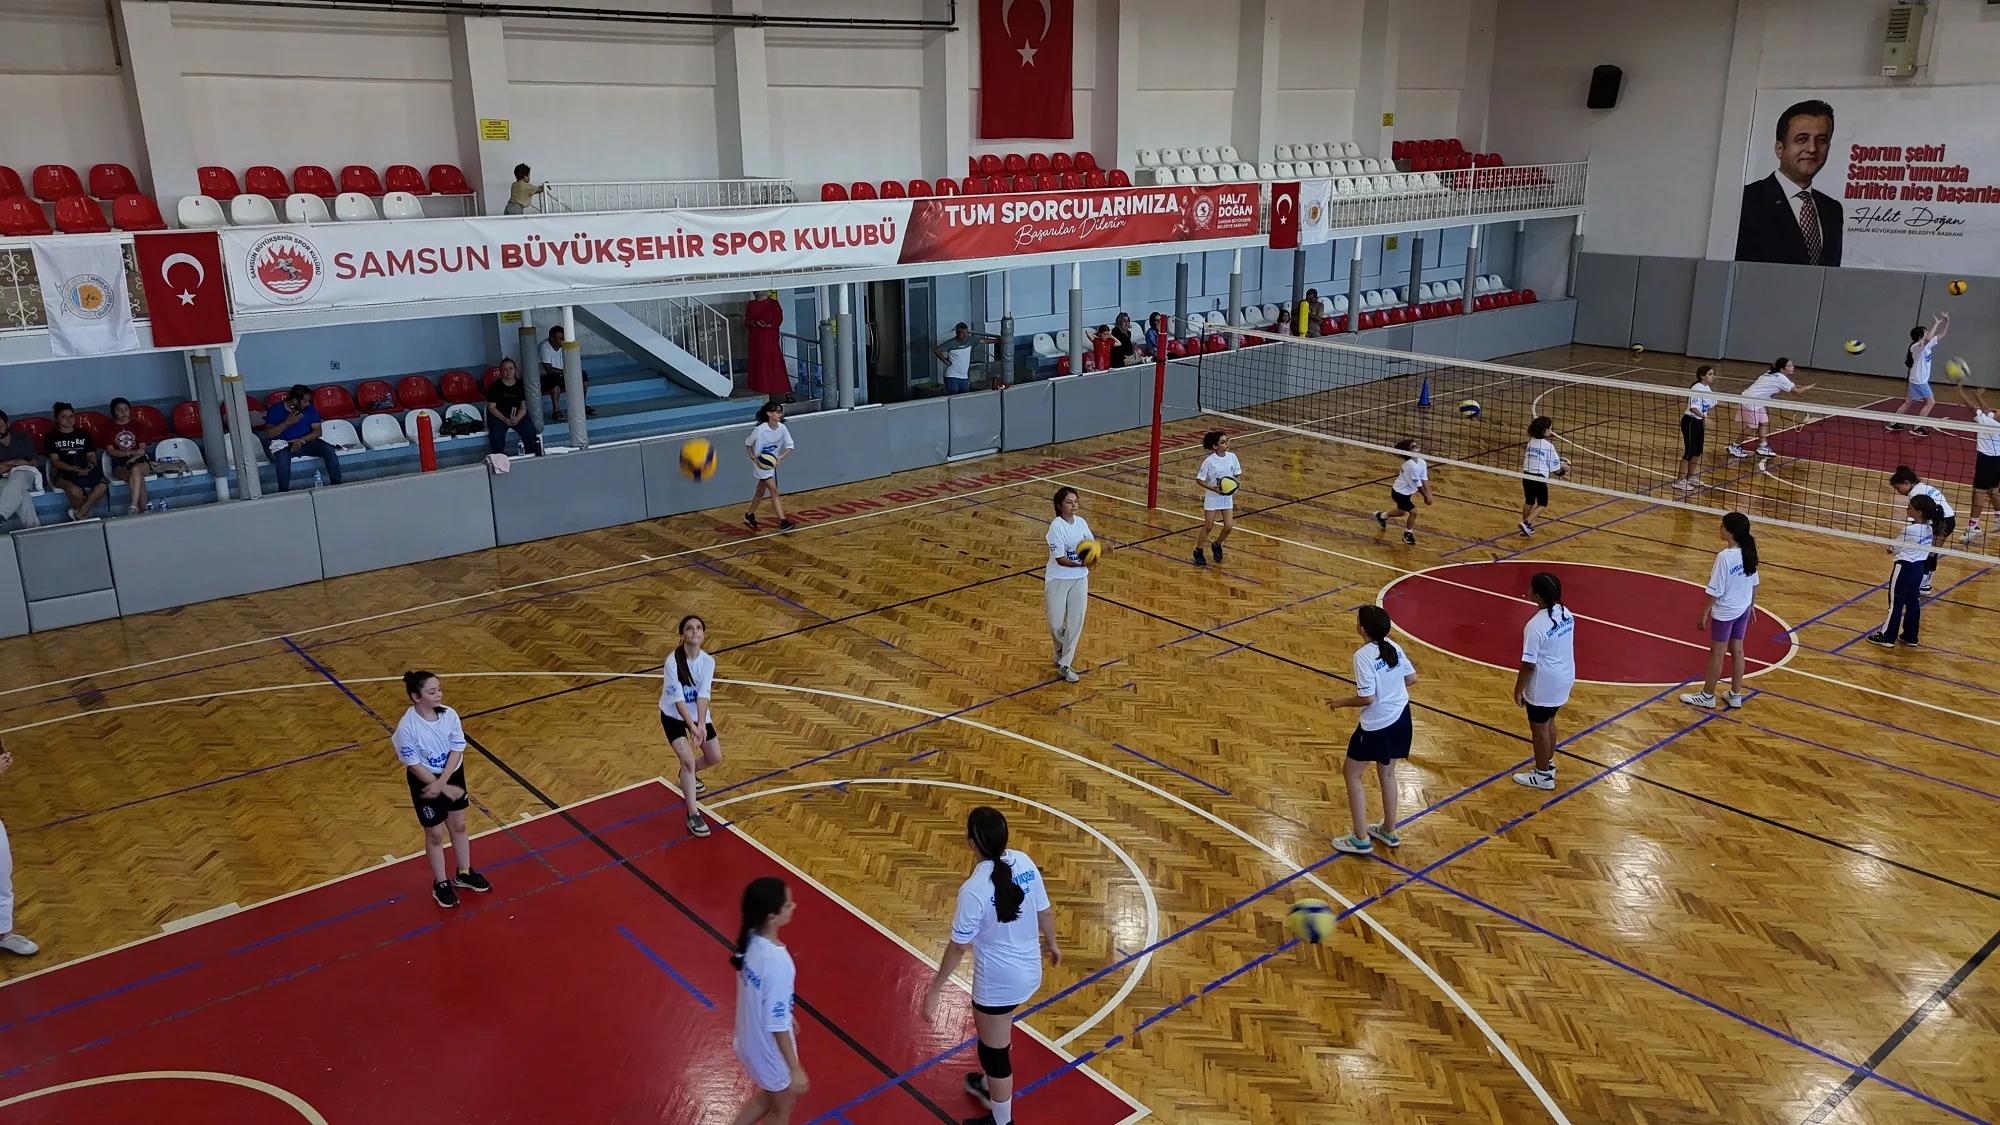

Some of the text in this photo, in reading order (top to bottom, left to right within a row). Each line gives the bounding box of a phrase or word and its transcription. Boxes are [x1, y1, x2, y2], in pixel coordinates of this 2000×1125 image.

[1850, 144, 1946, 163] Sporun şehri
[1847, 163, 1969, 183] Samsun'umuzda
[1844, 182, 1897, 200] birlikte
[1900, 183, 1934, 201] nice
[1001, 193, 1179, 224] SPORCULARIMIZA
[1218, 204, 1253, 218] DOĞAN
[1849, 206, 1902, 227] Halit
[1014, 221, 1077, 252] Başarılar
[334, 216, 896, 280] SAMSUN BÜYÜKŞEHİR SPOR KULUBÜ
[249, 252, 258, 280] SAMSUN
[293, 238, 311, 252] SPOR
